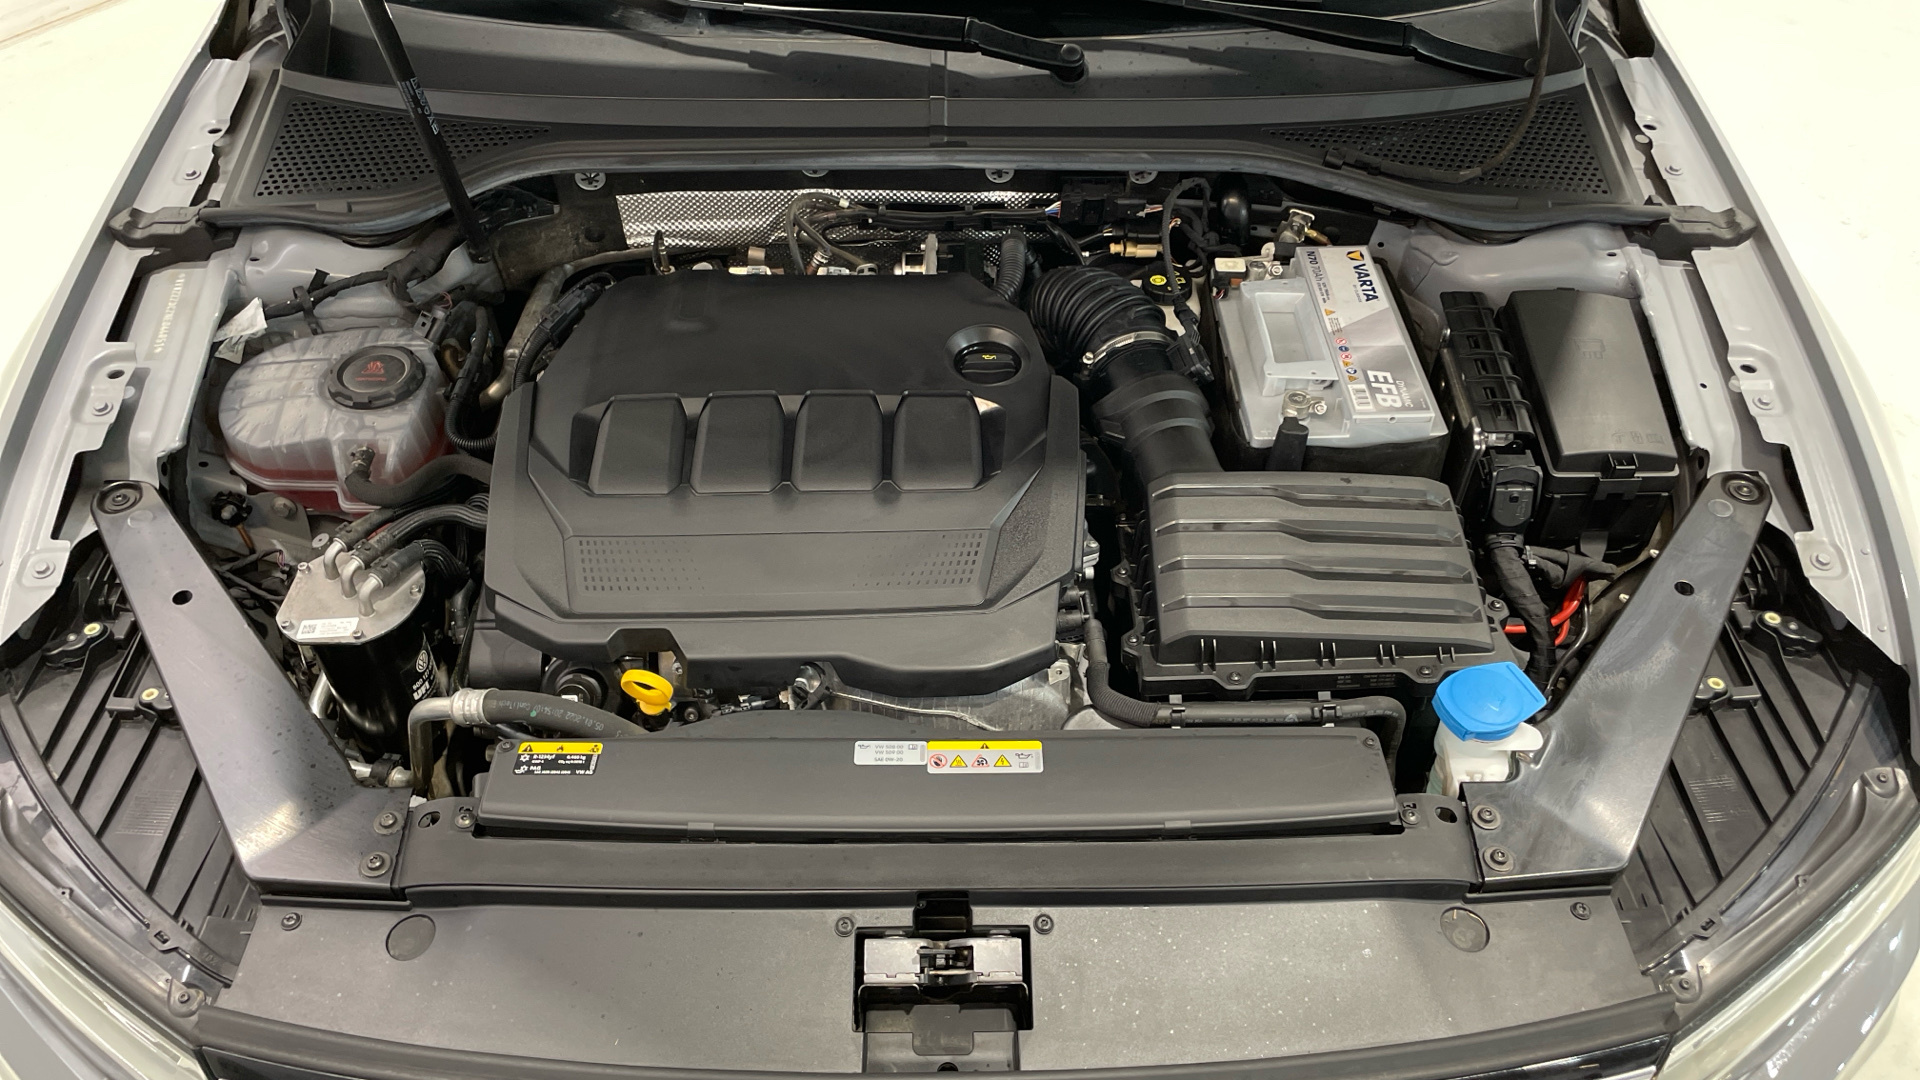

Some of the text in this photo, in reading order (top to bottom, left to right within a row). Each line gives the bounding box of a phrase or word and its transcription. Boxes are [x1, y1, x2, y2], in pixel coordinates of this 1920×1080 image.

[1306, 250, 1319, 265] N70
[1353, 263, 1379, 302] VARTA
[1367, 370, 1402, 408] EFB
[1396, 380, 1414, 408] DYNAMIC
